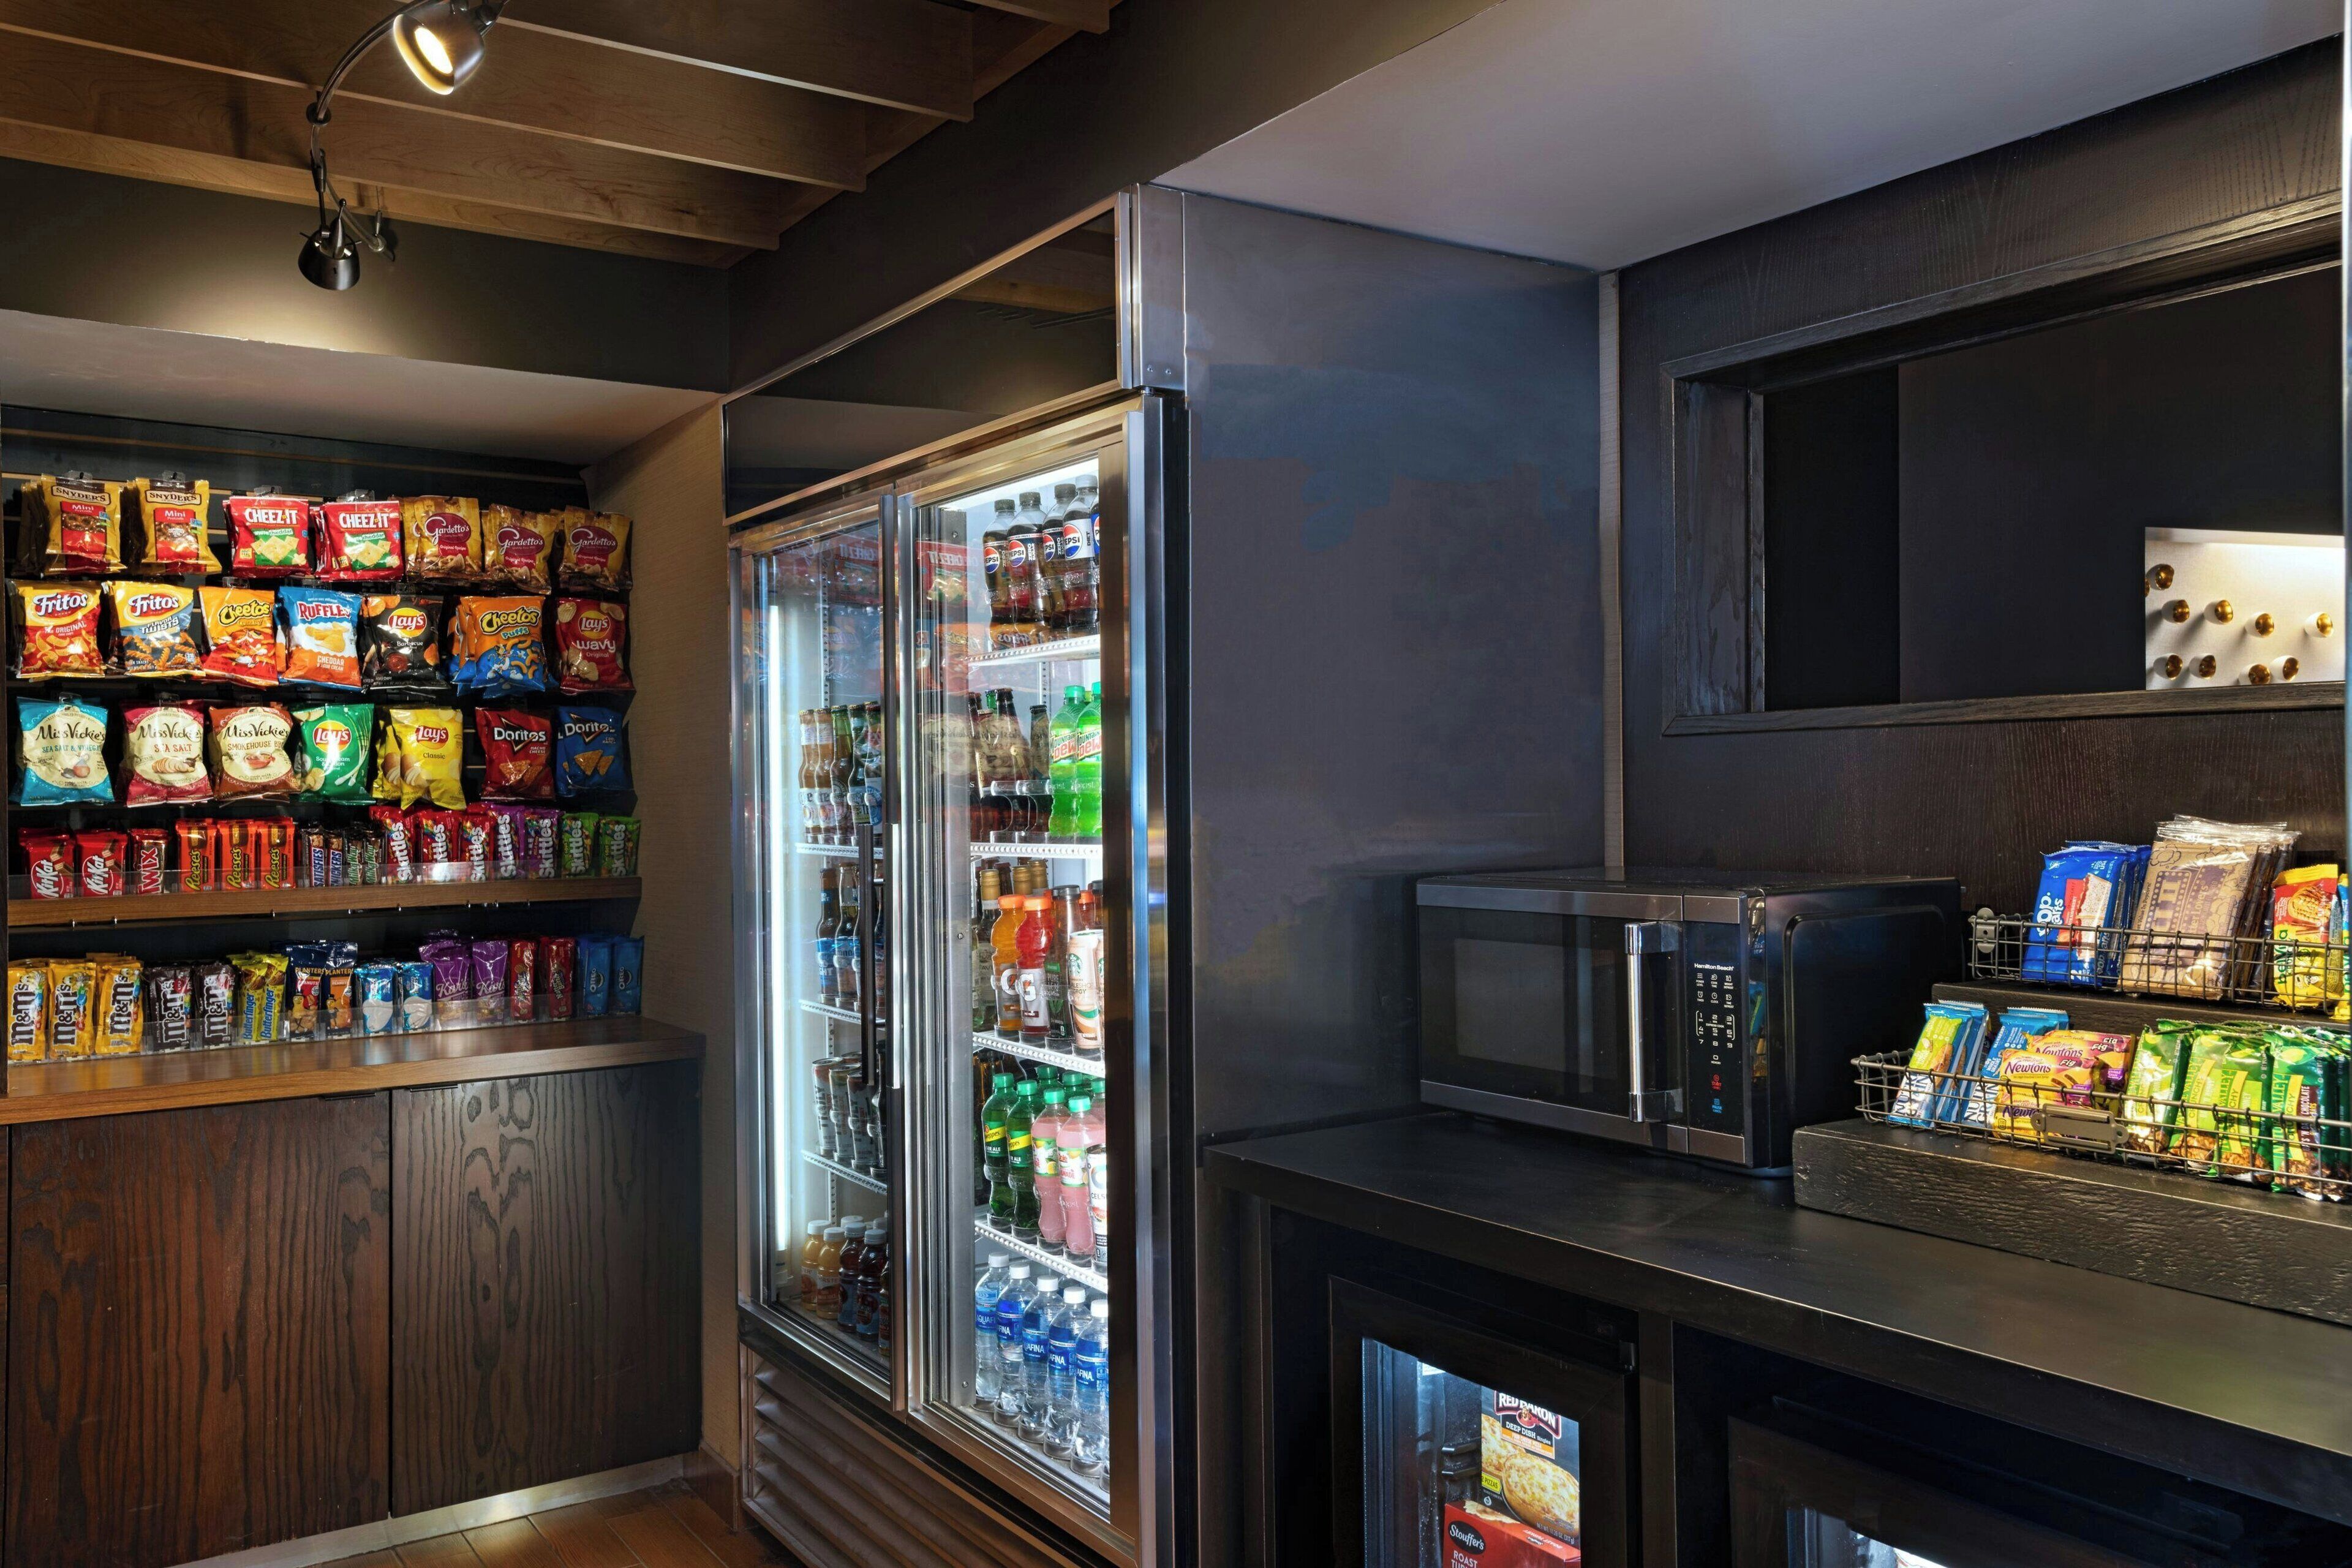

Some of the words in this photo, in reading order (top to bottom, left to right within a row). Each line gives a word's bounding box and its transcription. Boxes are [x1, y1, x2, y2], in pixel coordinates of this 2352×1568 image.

[55, 487, 106, 502] SNYDER'S
[149, 492, 197, 501] SNYDER'S
[424, 516, 469, 546] Gardetto's
[497, 528, 543, 555] Gardetto's
[570, 528, 616, 555] Gardetto's
[32, 593, 88, 617] Fritos
[128, 594, 179, 615] Fritos
[219, 600, 270, 625] Cheetos
[56, 622, 87, 633] ORIGINAL
[140, 620, 179, 635] TWISTS
[392, 612, 424, 630] Lay's
[481, 608, 538, 632] Cheetos
[582, 616, 608, 631] Lay's
[502, 627, 529, 638] Puffs
[317, 655, 344, 666] CHEDDAR
[66, 722, 105, 744] Vickie's
[224, 725, 252, 739] Miss
[249, 721, 288, 739] Vickie's
[417, 726, 447, 743] Lay's
[494, 727, 546, 741] Doritos
[173, 744, 192, 752] SALT
[228, 741, 272, 750] SMOKEHOUSE
[392, 822, 413, 881] Skittles
[469, 827, 486, 882] Skittles
[497, 815, 516, 877] Skittles
[539, 819, 554, 878] Skittles
[569, 821, 586, 873] Skittles
[610, 824, 627, 876] Skittles
[185, 850, 200, 891] Reese's
[227, 848, 243, 888] Reese's
[266, 848, 280, 888] Reese's
[260, 988, 275, 1039] Butterfinger
[2092, 1043, 2108, 1052] Fig
[2005, 1062, 2051, 1074] Newtons
[2301, 1086, 2310, 1115] CHOCOLATE
[1506, 1421, 1521, 1433] DEEP
[1521, 1427, 1536, 1439] DISH
[1484, 1477, 1498, 1488] PIZZAS
[1450, 1525, 1485, 1551] Stouffer's
[1453, 1550, 1477, 1568] ROAST
